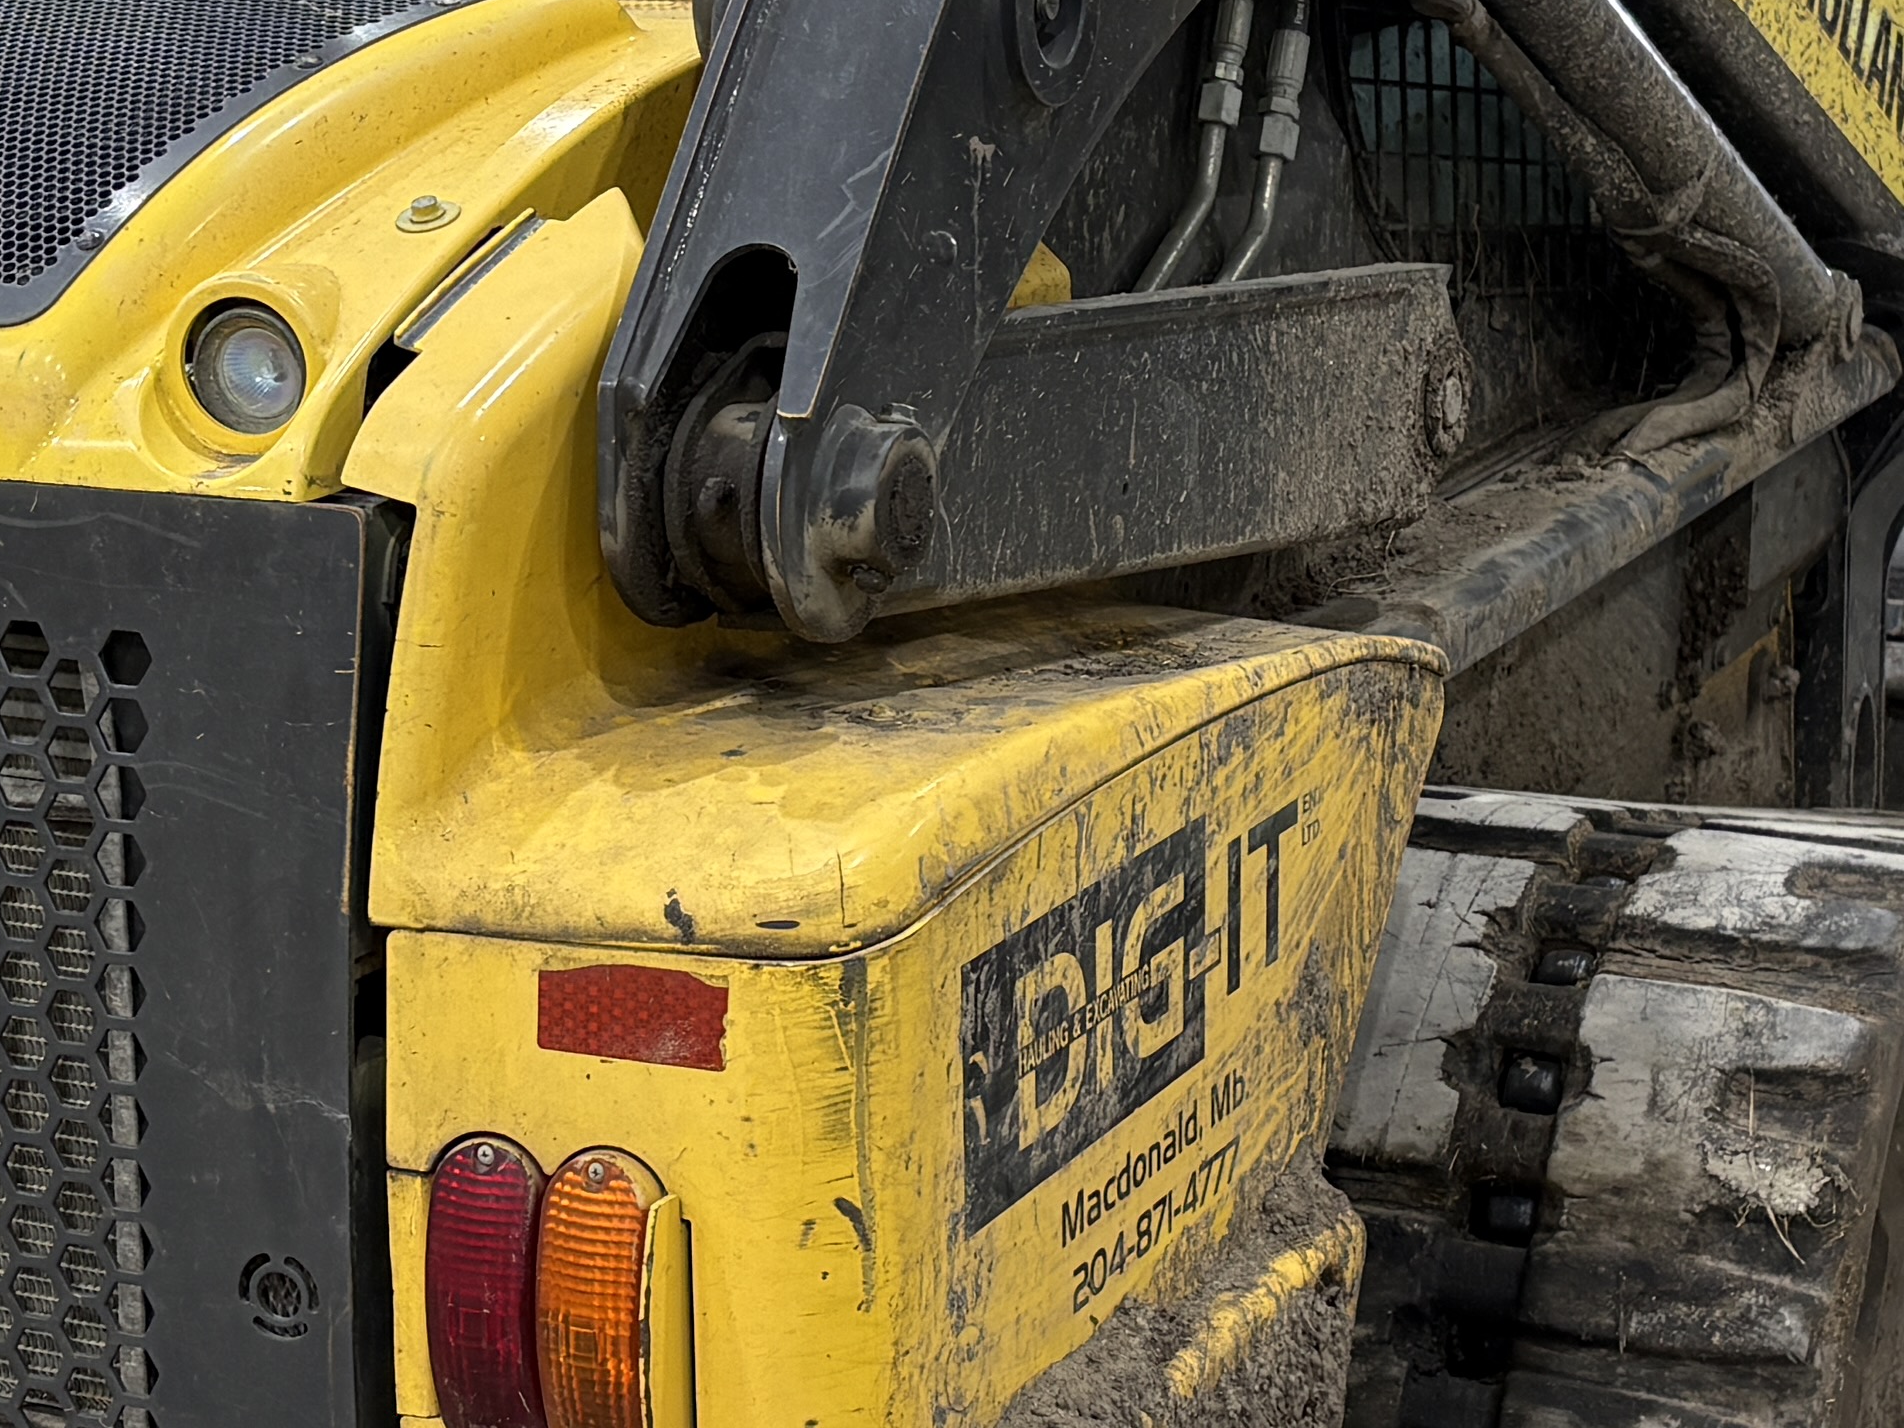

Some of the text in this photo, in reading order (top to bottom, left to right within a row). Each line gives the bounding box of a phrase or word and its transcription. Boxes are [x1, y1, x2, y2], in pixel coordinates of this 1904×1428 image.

[1014, 798, 1298, 1152] DIG-IT
[1018, 963, 1150, 1076] HAULING & EXCAVATING
[1061, 1098, 1203, 1249] Macdonald,
[1072, 1134, 1242, 1315] 204-871-4777
